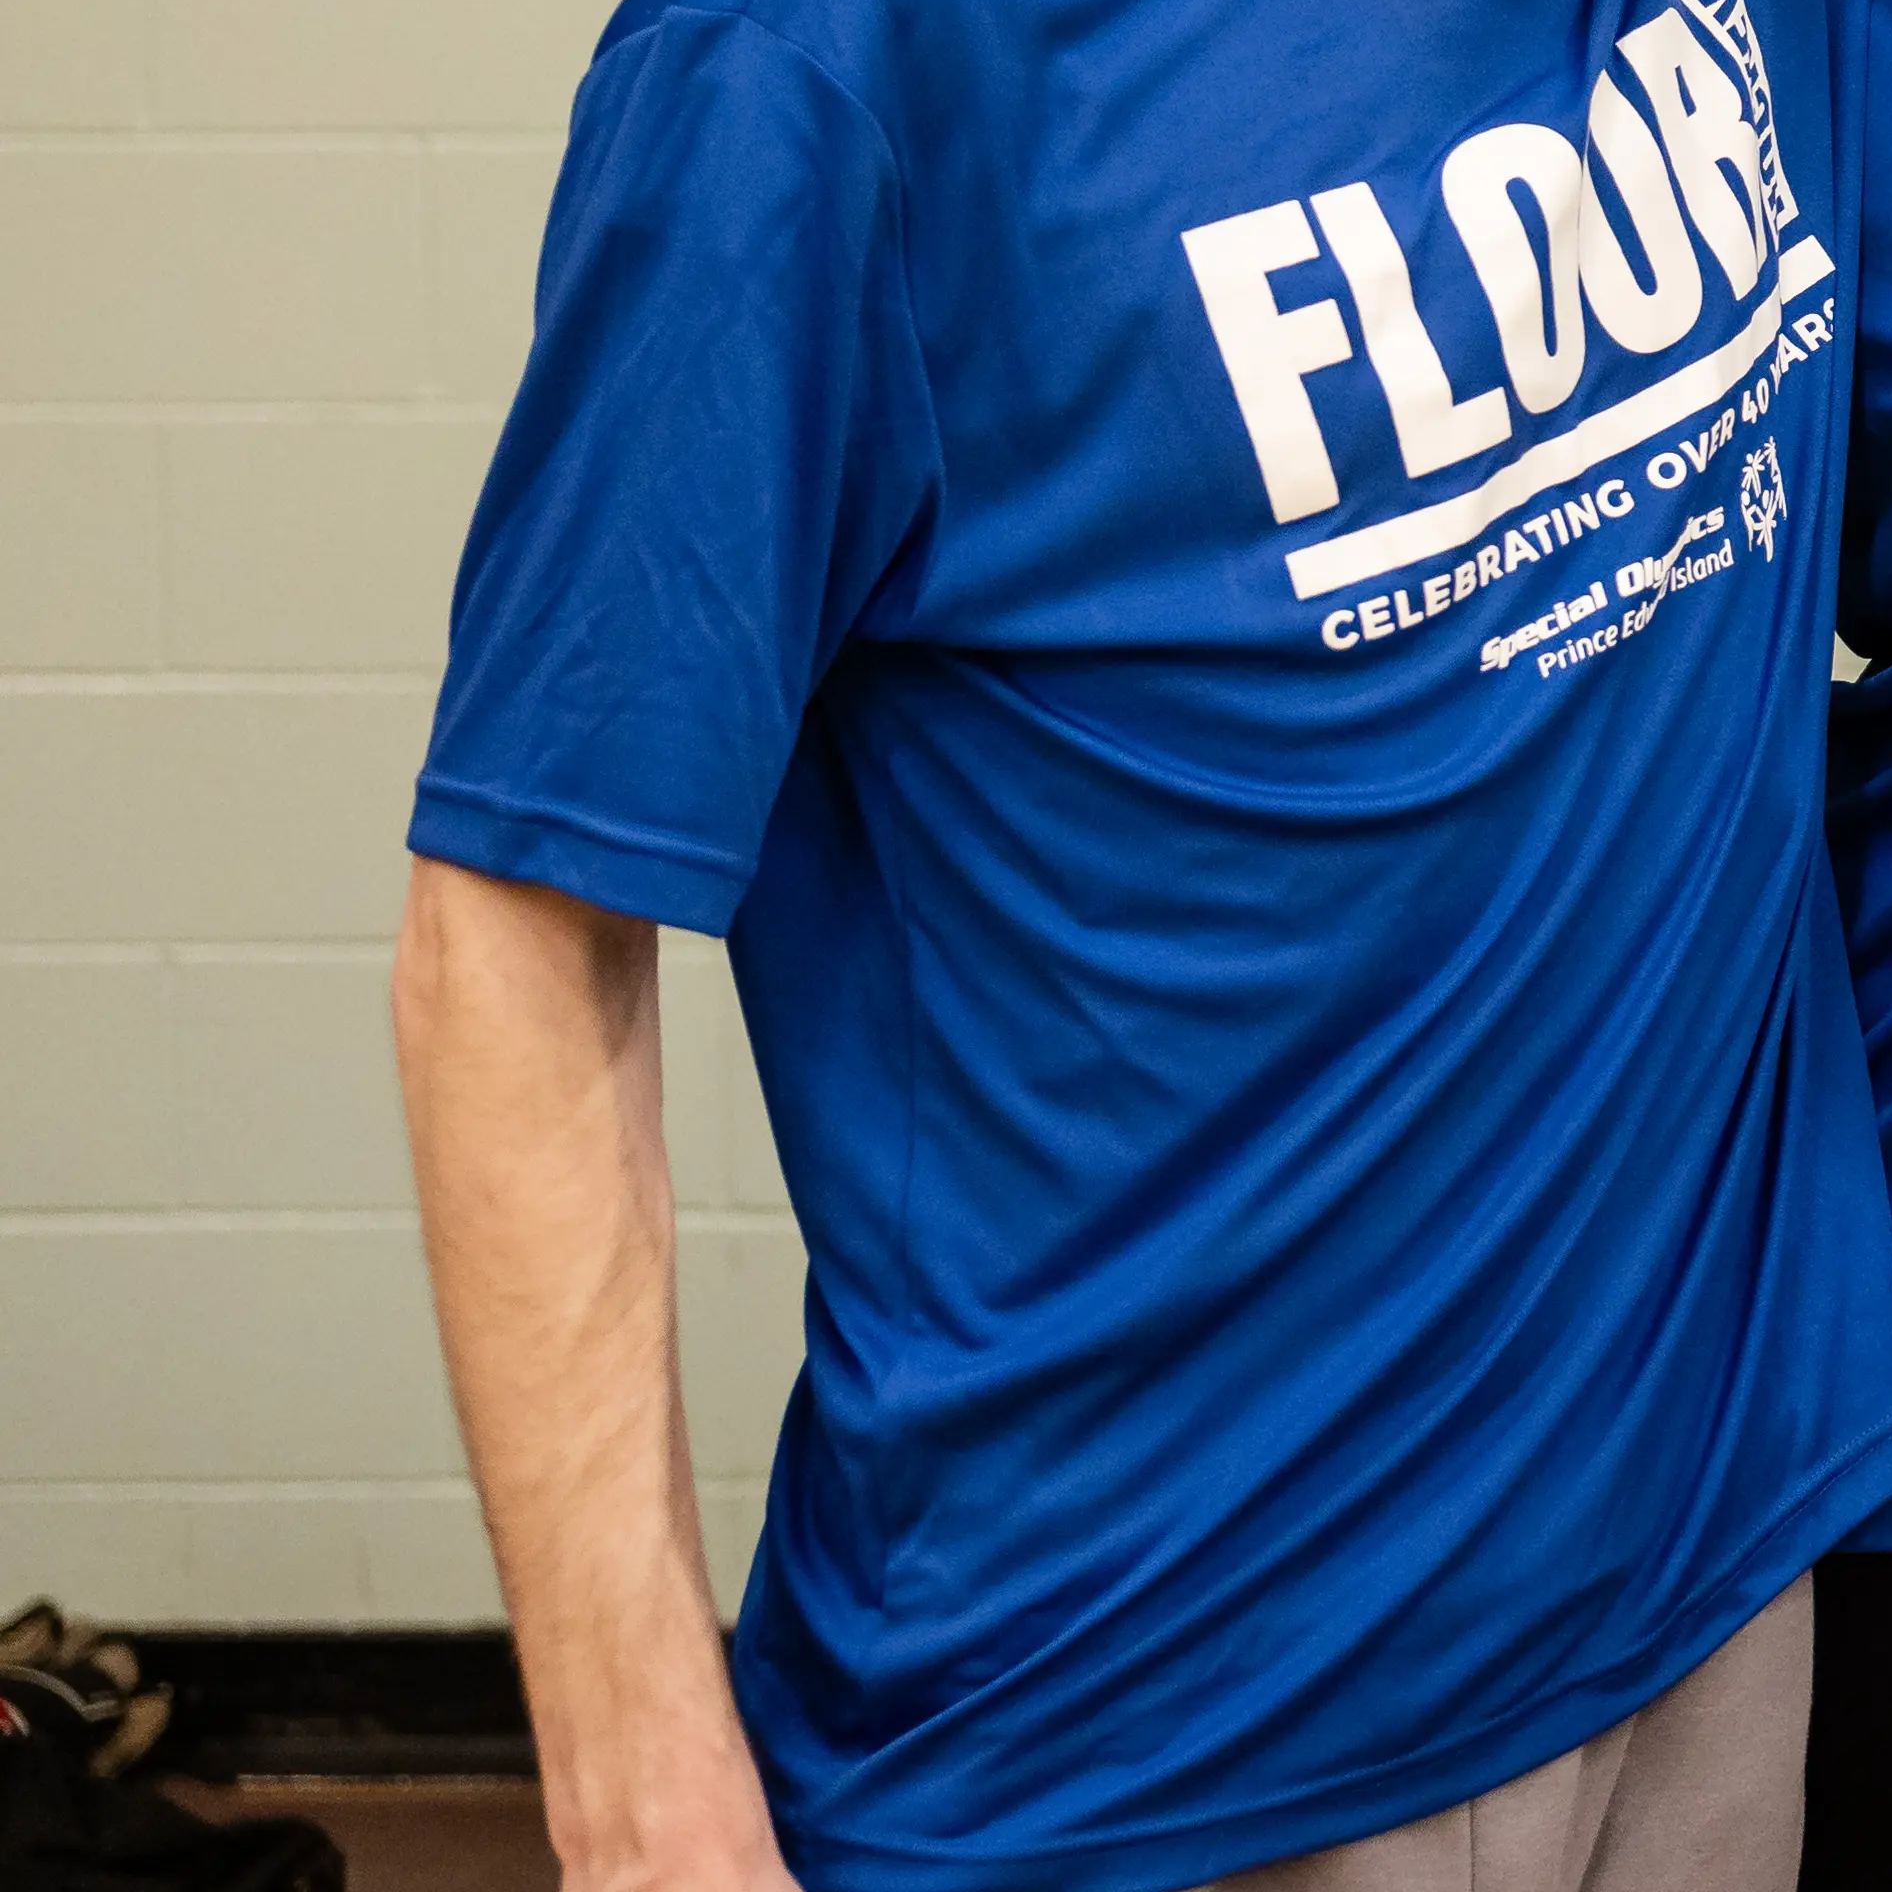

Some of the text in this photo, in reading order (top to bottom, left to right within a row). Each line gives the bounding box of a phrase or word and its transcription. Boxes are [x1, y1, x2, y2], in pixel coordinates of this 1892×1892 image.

[1181, 6, 1768, 525] FLOOR
[1320, 479, 1636, 652] CELEBRATING
[1645, 407, 1736, 490] OVER
[1741, 377, 1770, 424] 40
[1536, 624, 1618, 679] Prince
[1669, 537, 1735, 593] Island
[1480, 581, 1609, 672] Special
